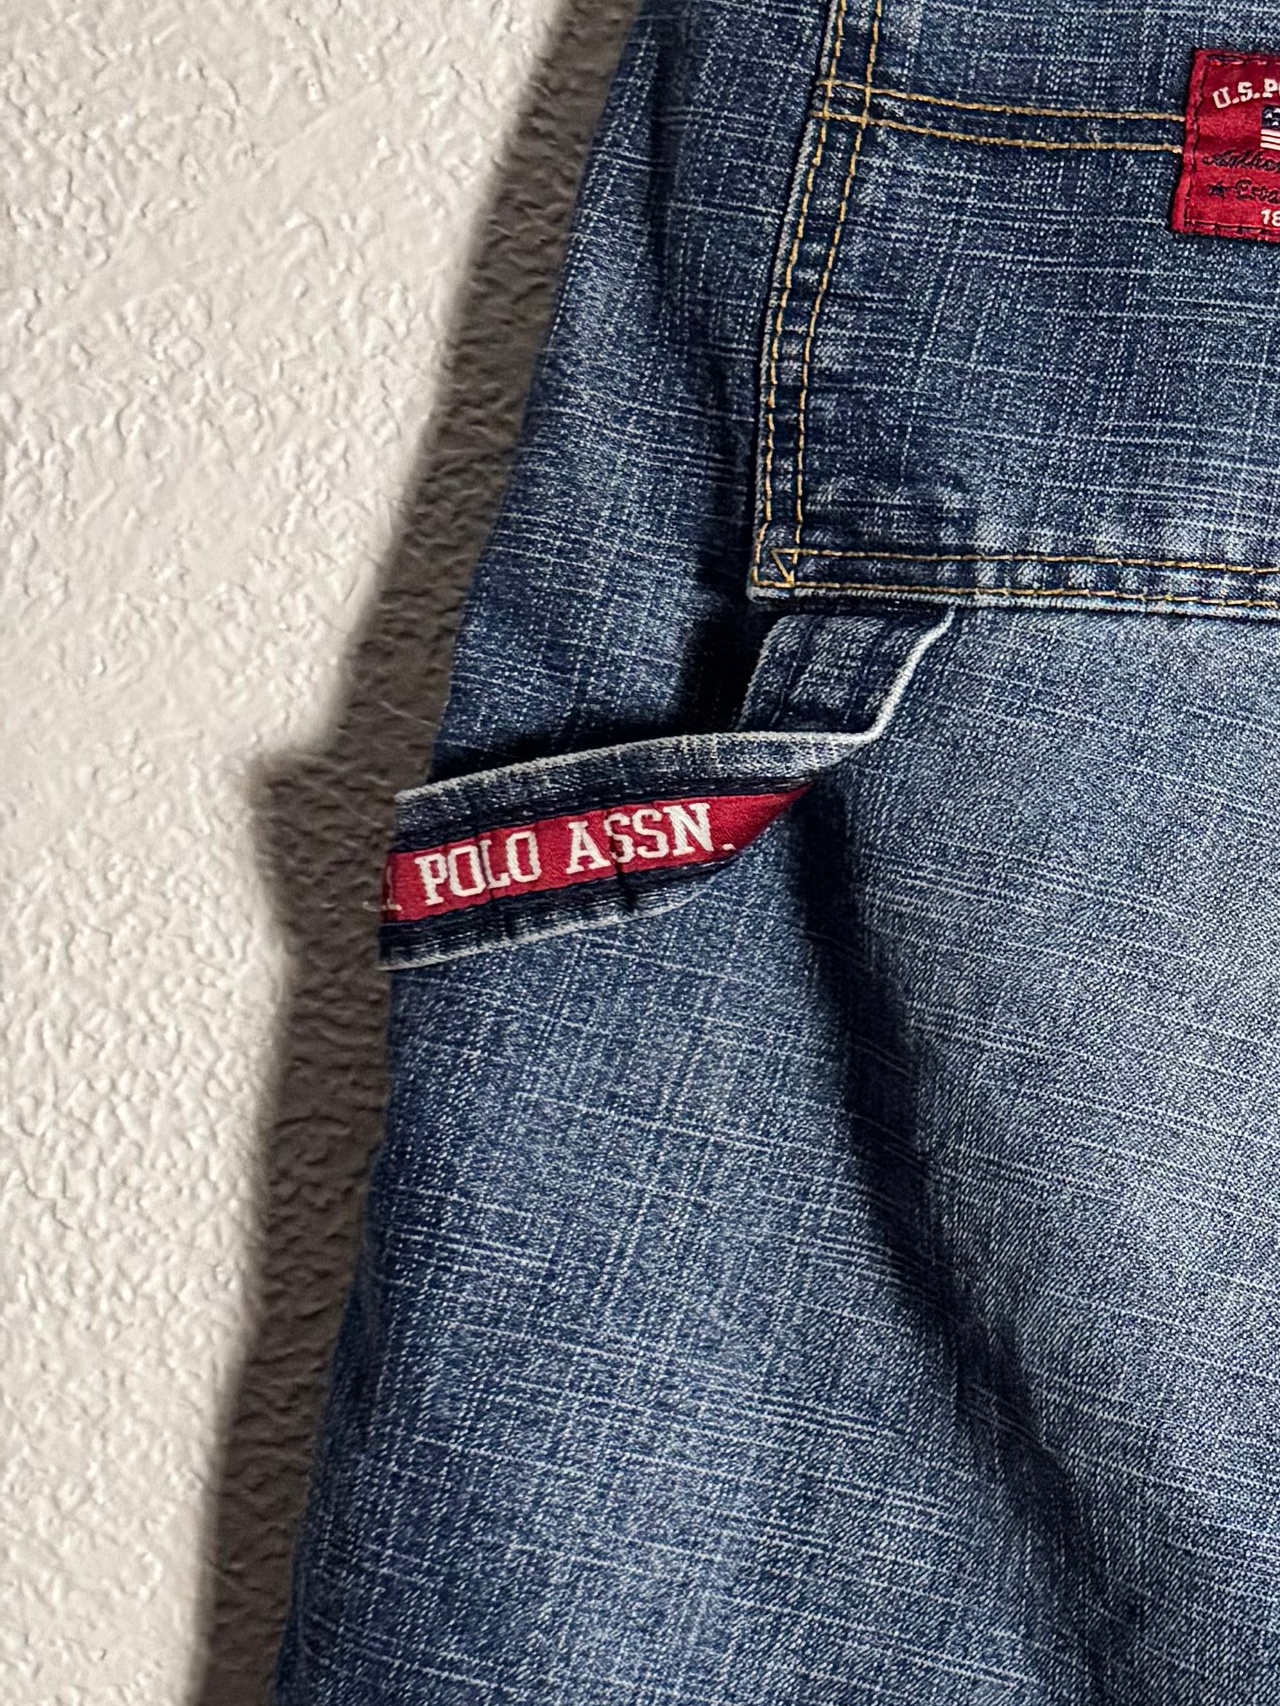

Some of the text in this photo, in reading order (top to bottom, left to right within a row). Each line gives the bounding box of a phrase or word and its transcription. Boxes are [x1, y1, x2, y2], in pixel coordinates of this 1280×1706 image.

[1212, 80, 1261, 109] U.S.
[414, 801, 736, 906] POLO ASSN.
